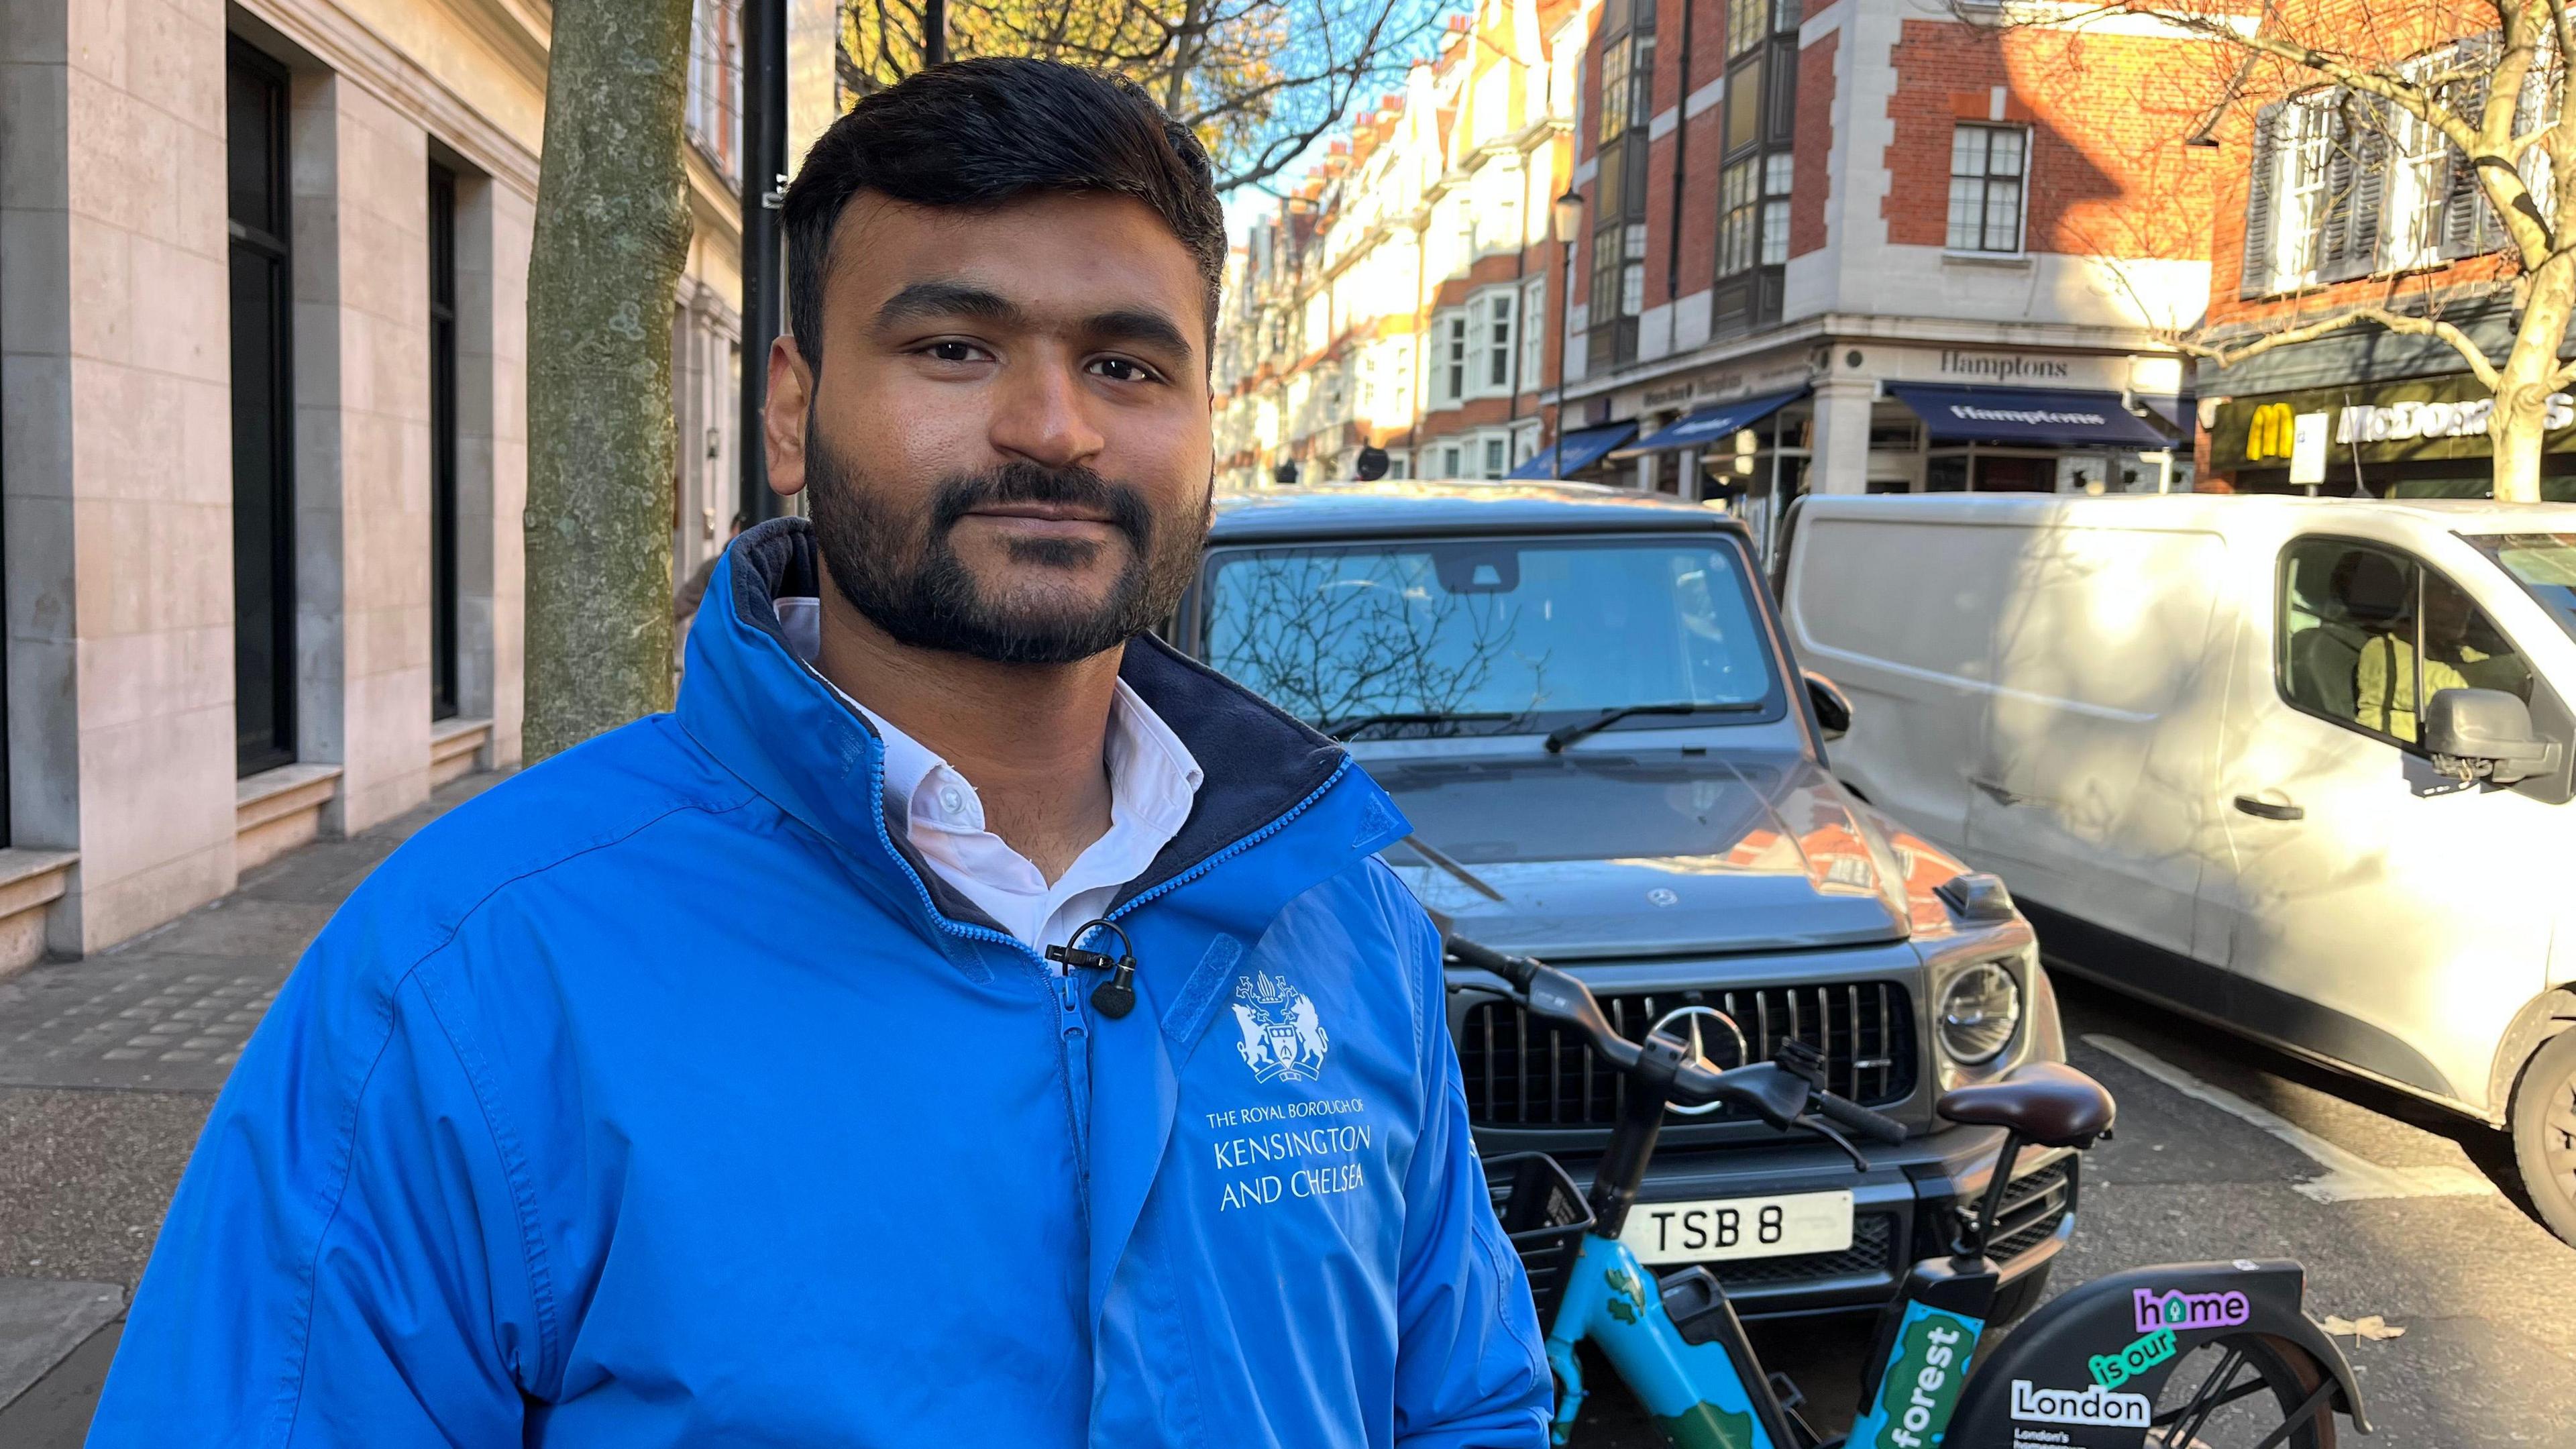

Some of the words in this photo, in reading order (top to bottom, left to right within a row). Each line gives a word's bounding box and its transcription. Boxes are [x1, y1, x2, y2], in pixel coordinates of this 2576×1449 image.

[1941, 350, 2068, 381] Hamptons
[1950, 405, 2105, 425] Hamptons
[1206, 1112, 1237, 1129] THE
[1242, 1105, 1285, 1123] ROYAL
[1289, 1099, 1350, 1118] BOROUGH
[1352, 1099, 1364, 1112] OF
[1214, 1125, 1371, 1169] KENSINGTON
[1220, 1175, 1282, 1212] AND
[1291, 1163, 1364, 1197] CHELSEA
[1651, 1208, 1739, 1251] TSB
[1758, 1205, 1782, 1244] 8
[2095, 1362, 2123, 1383] is
[2128, 1334, 2167, 1367] our
[1891, 1326, 1960, 1448] forest
[2019, 1389, 2143, 1419] London
[2014, 1427, 2070, 1444] London's
